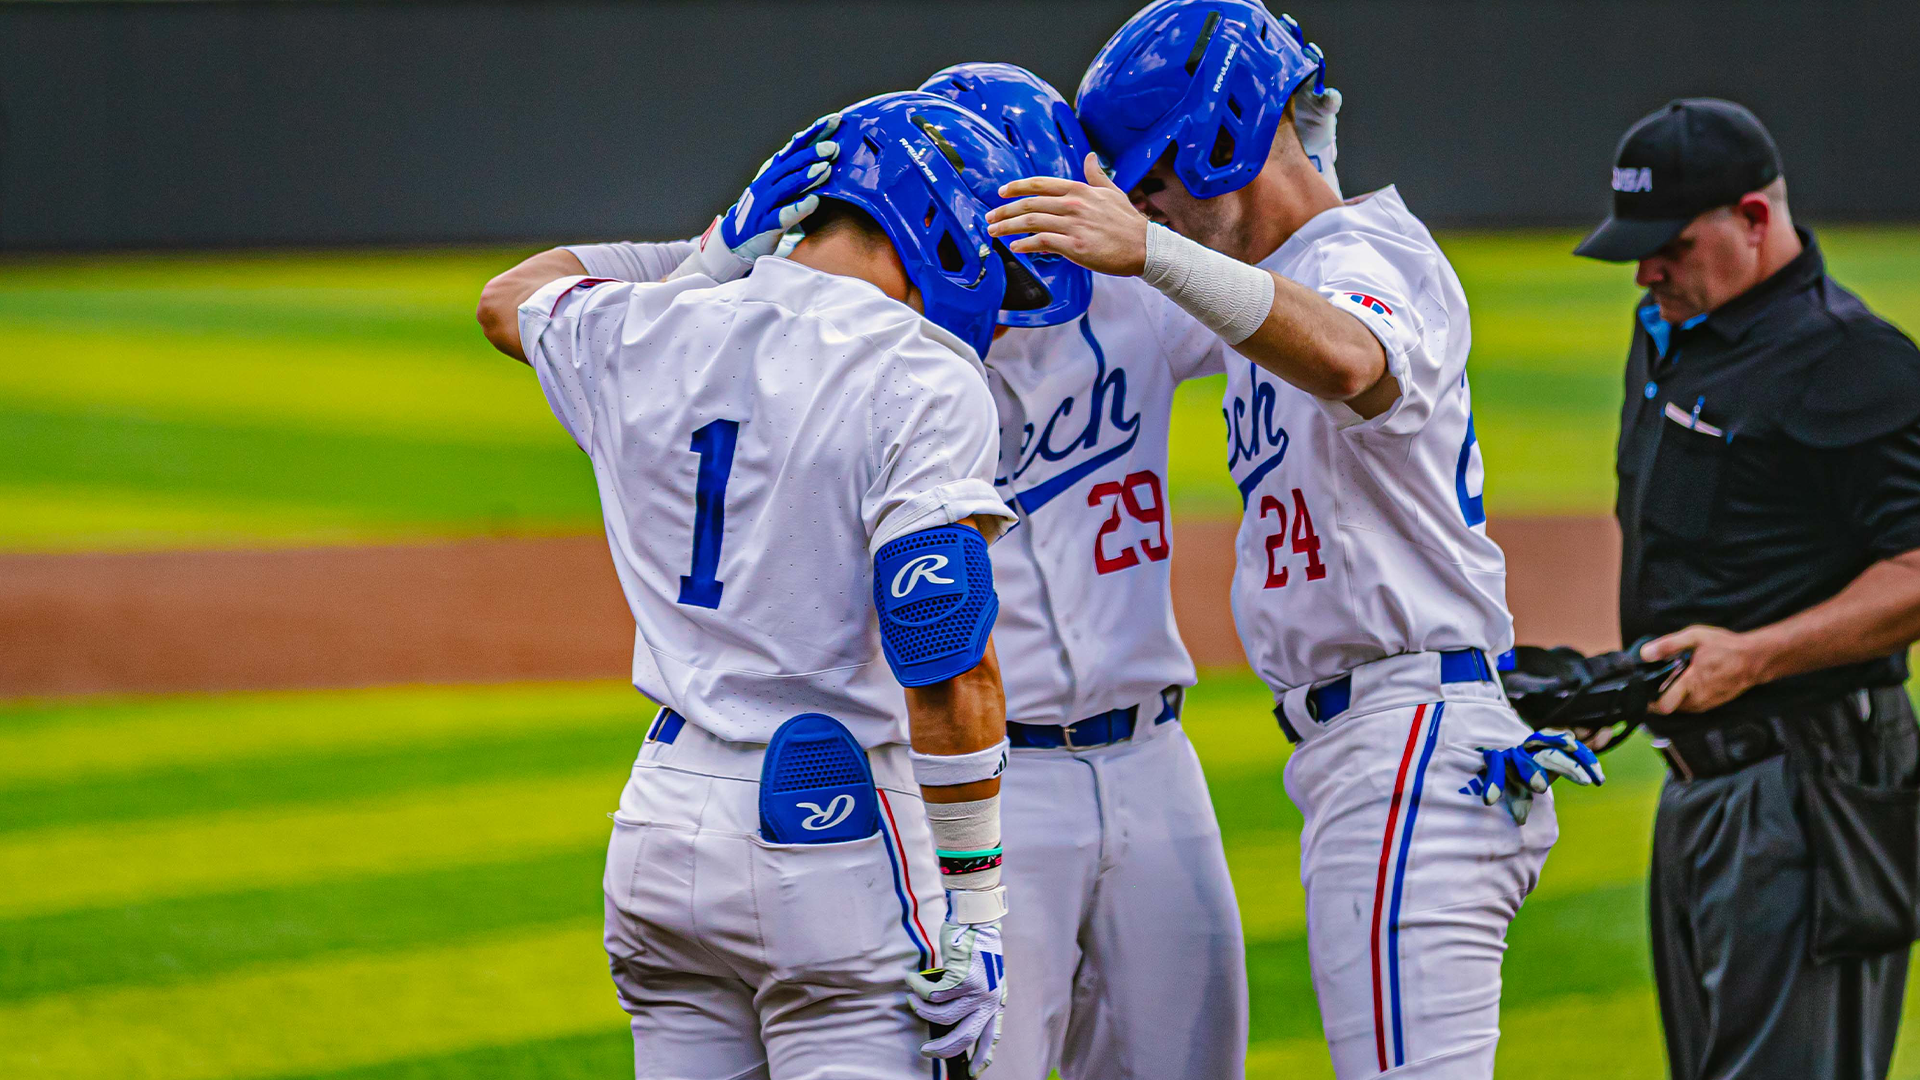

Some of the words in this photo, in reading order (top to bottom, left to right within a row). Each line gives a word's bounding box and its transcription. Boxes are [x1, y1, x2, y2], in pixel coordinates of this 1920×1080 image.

[677, 418, 740, 610] 1
[1087, 470, 1169, 575] 29
[1260, 488, 1327, 590] 24
[891, 554, 955, 598] R
[796, 794, 855, 831] R
